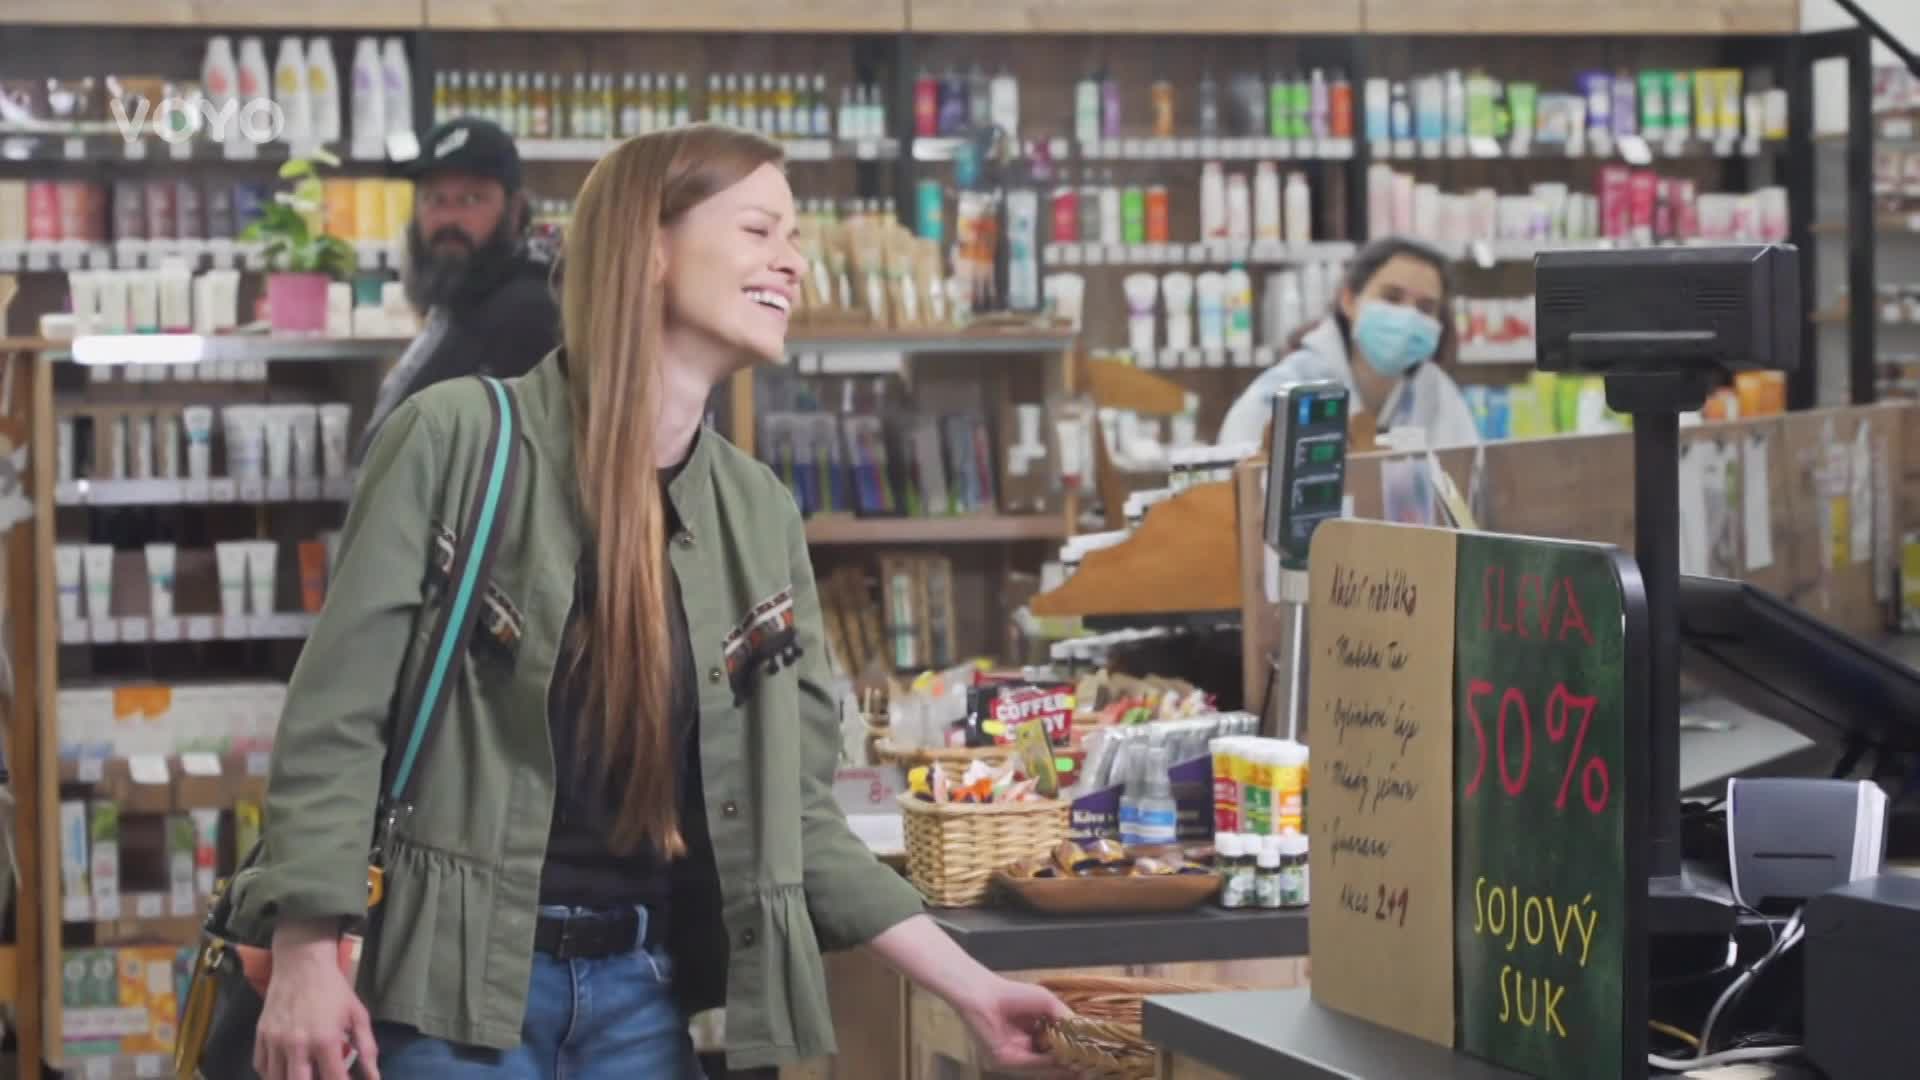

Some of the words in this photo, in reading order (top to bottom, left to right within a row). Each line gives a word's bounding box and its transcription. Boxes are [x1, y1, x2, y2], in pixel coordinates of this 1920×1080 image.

[1479, 564, 1597, 647] SLEVA
[1474, 877, 1598, 967] SOJOVÝ
[1500, 966, 1566, 1037] SUK
